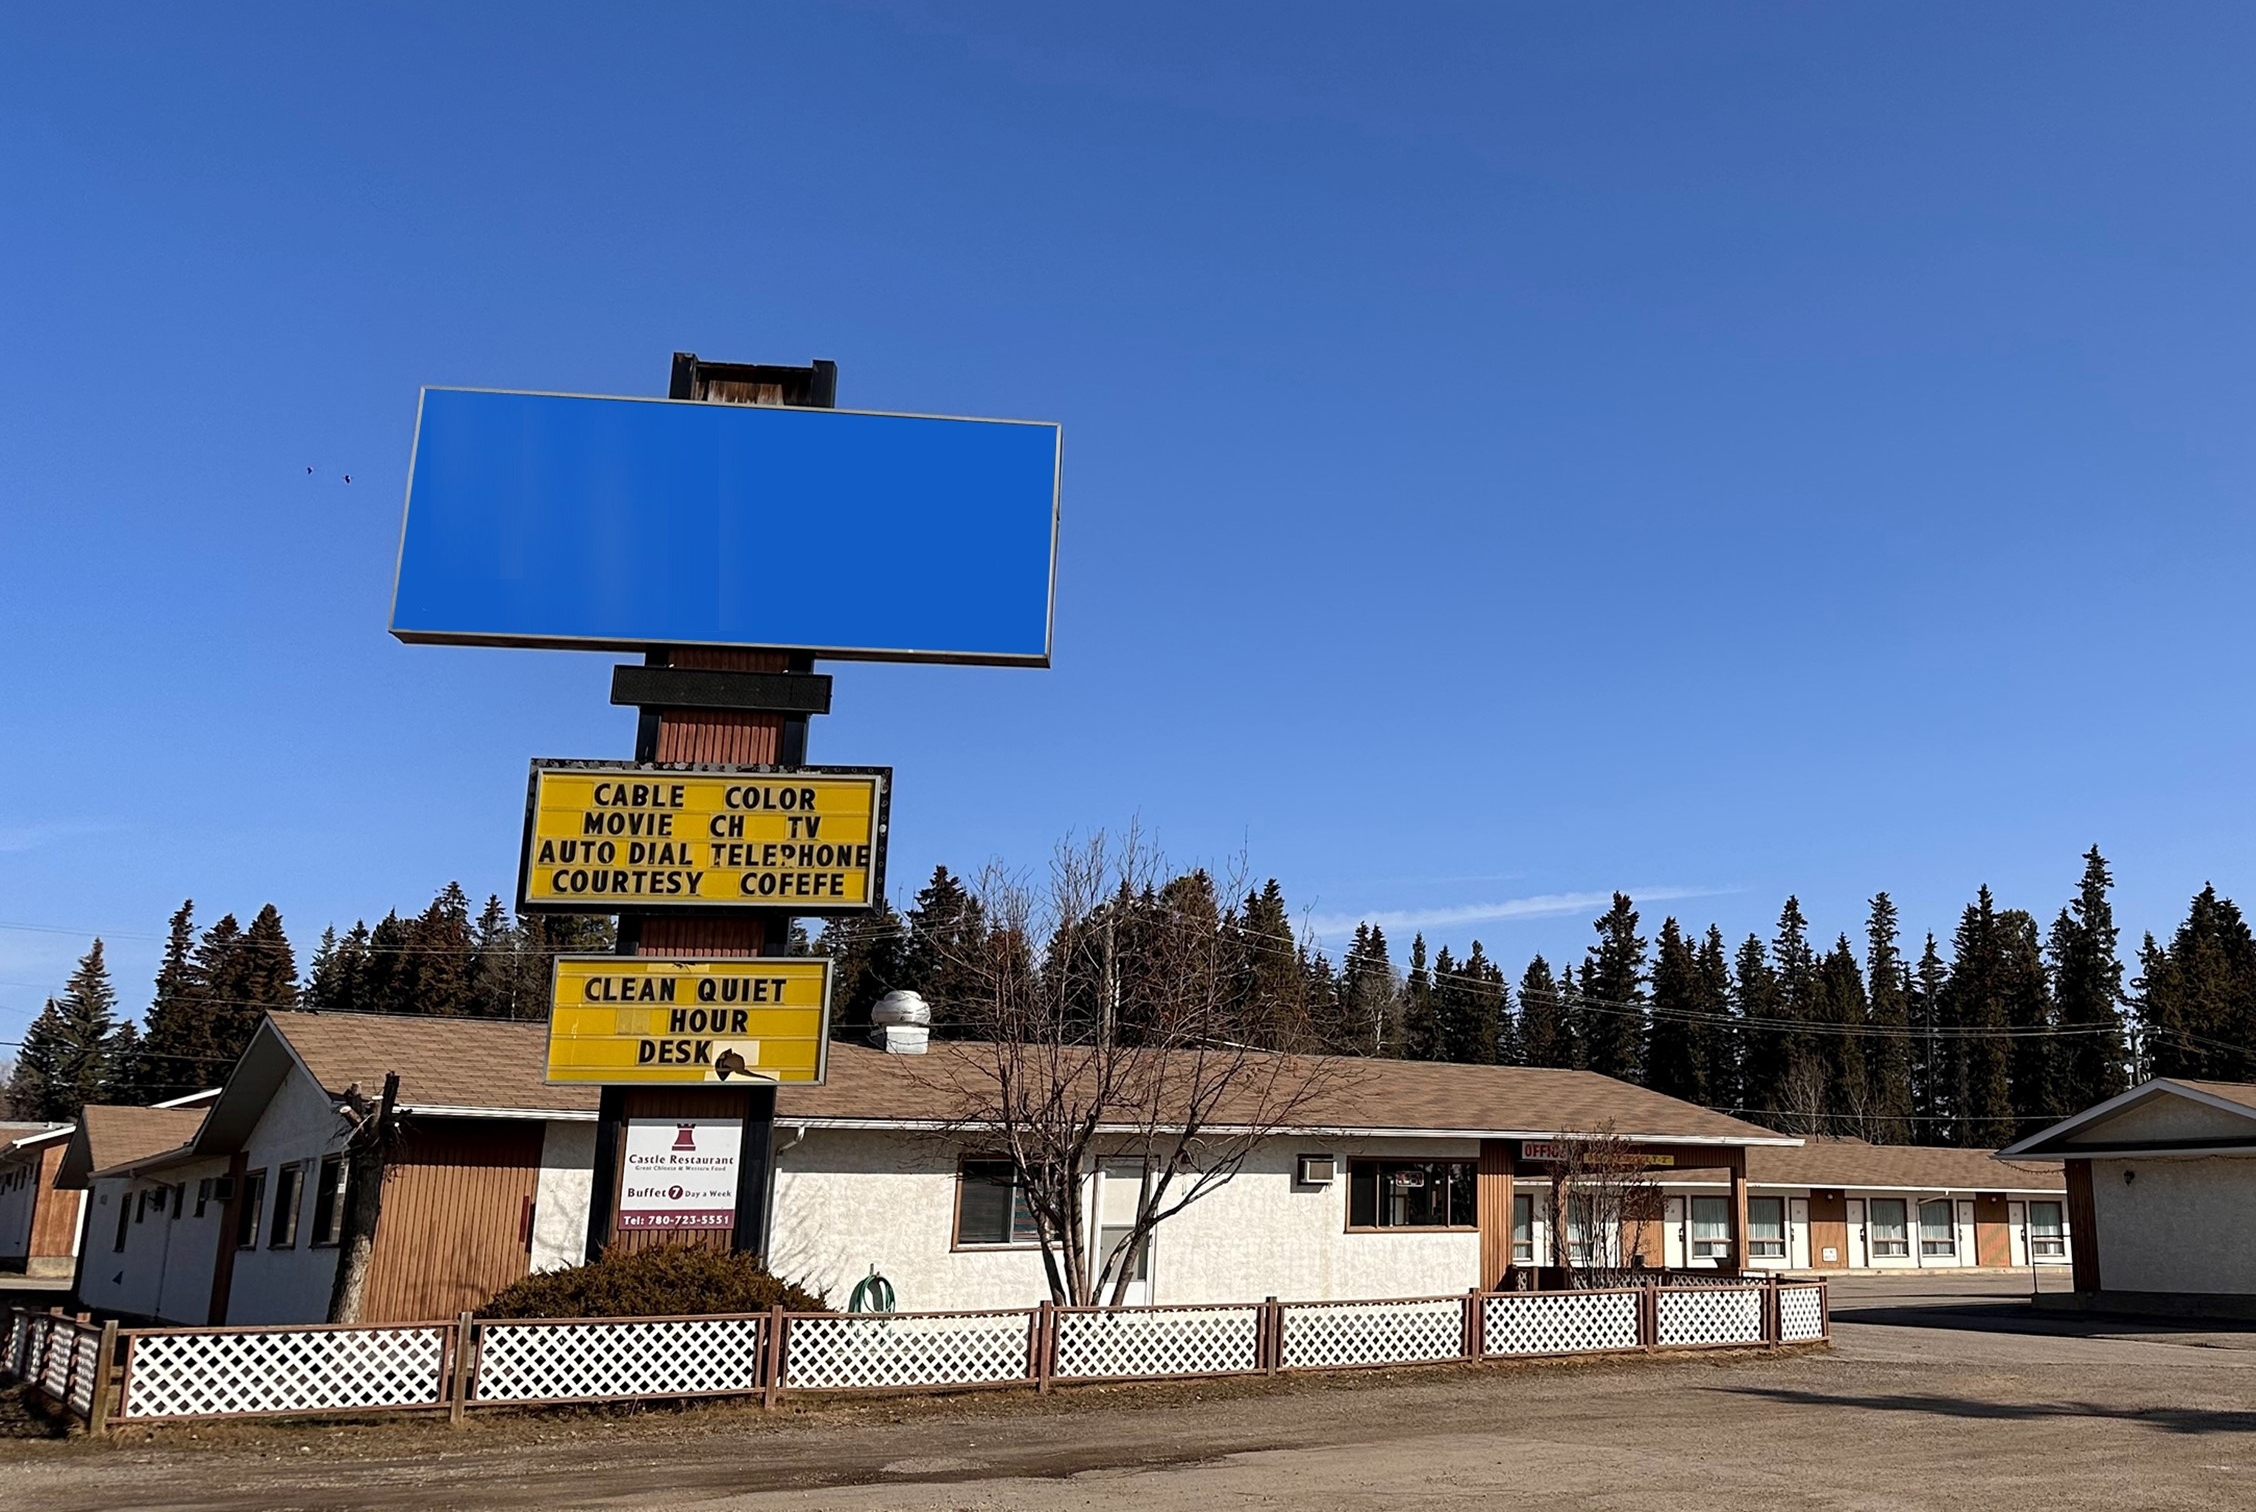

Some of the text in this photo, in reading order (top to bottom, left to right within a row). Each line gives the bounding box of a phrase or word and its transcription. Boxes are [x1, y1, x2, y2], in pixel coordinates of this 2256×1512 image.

[594, 783, 816, 810] CABLE COLOR
[583, 811, 821, 839] MOVIE CH TV
[538, 840, 870, 868] AUTO DIAL TELEPHONE
[552, 868, 845, 896] COURTESY COFEFE
[584, 976, 787, 1003] CLEAN QUIET
[669, 1008, 748, 1033] HOUR
[638, 1039, 713, 1064] DESK
[629, 1154, 734, 1165] Castle Restaurant
[628, 1188, 667, 1197] Buffet
[672, 1188, 680, 1197] 7
[685, 1191, 700, 1199] Day
[623, 1215, 729, 1226] Tel: 780-723-5551
